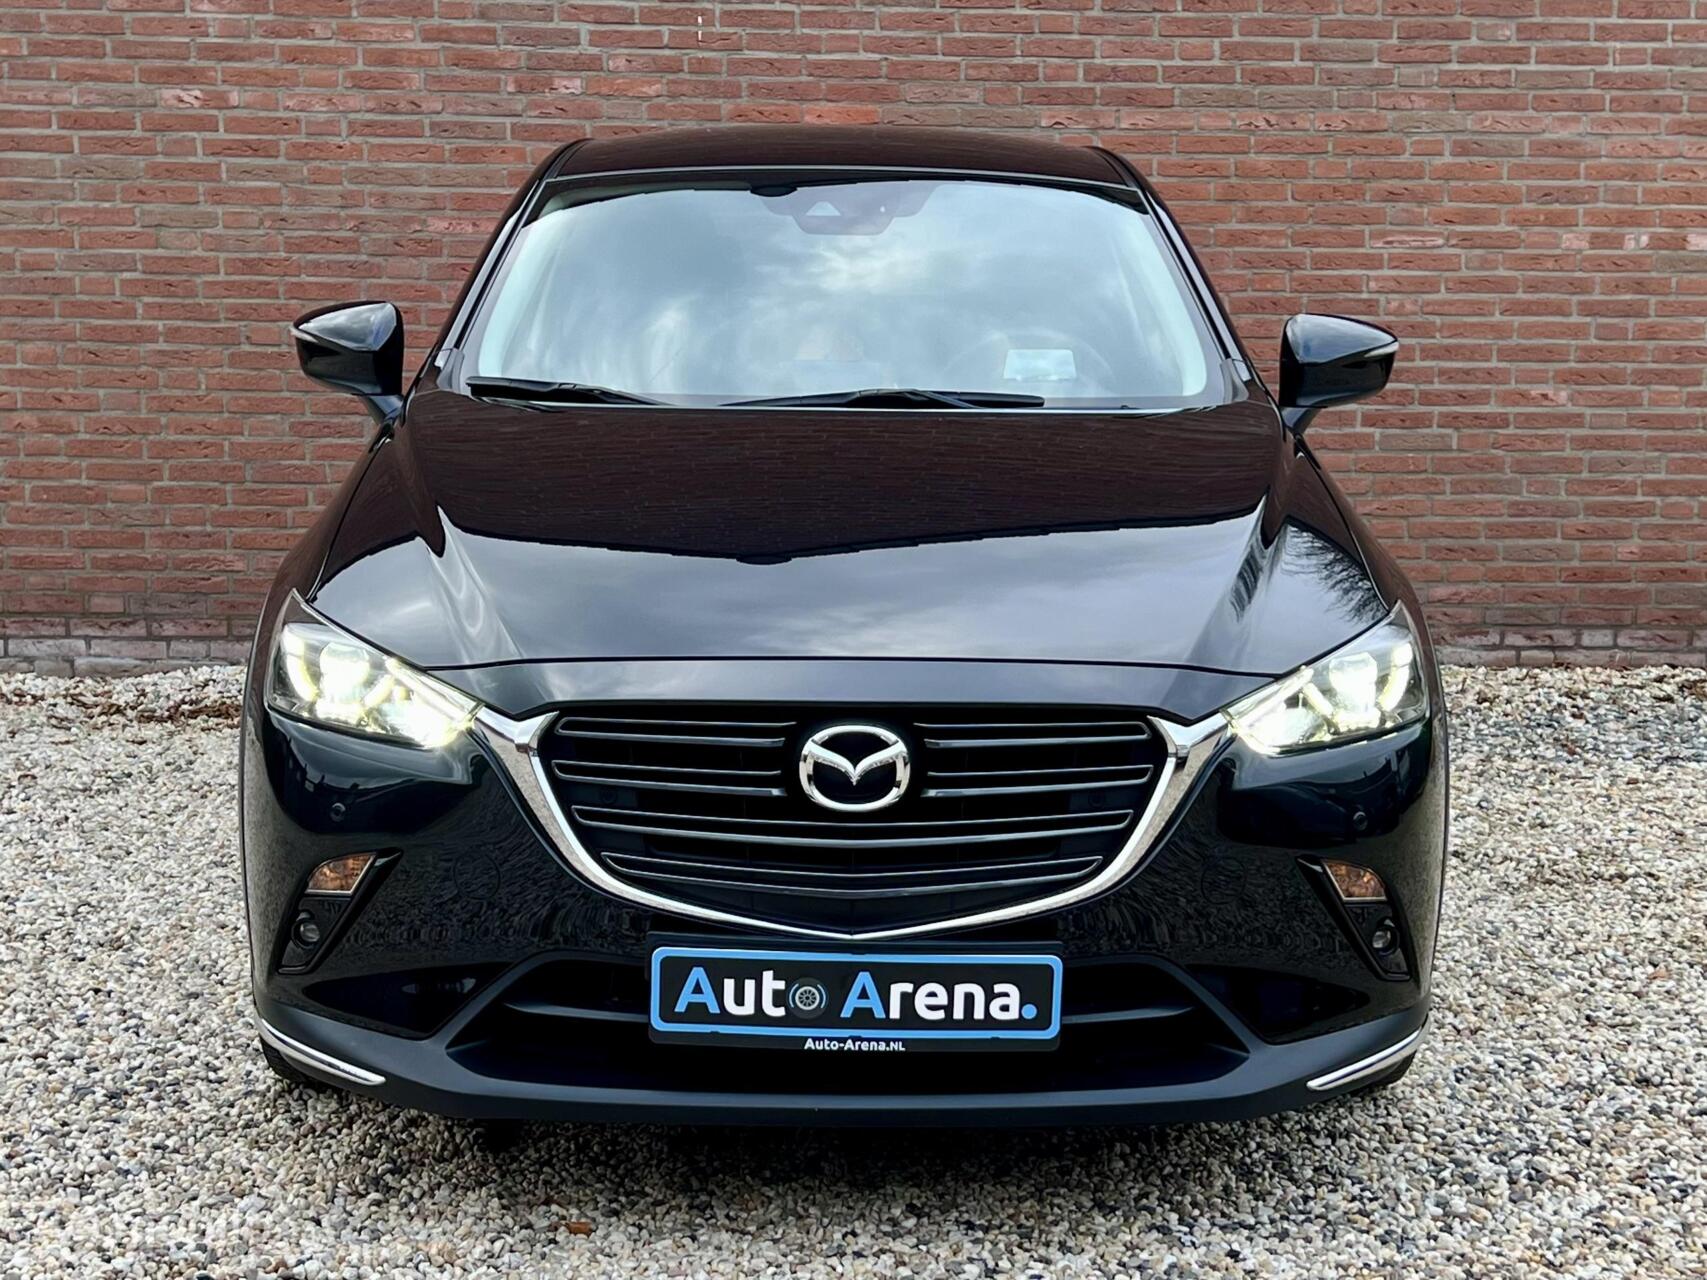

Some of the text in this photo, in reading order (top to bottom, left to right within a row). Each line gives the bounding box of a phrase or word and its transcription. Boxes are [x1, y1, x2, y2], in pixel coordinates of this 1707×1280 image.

[674, 966, 1037, 1021] Auto Arena.
[804, 1037, 906, 1051] Auto-Arena.NL
